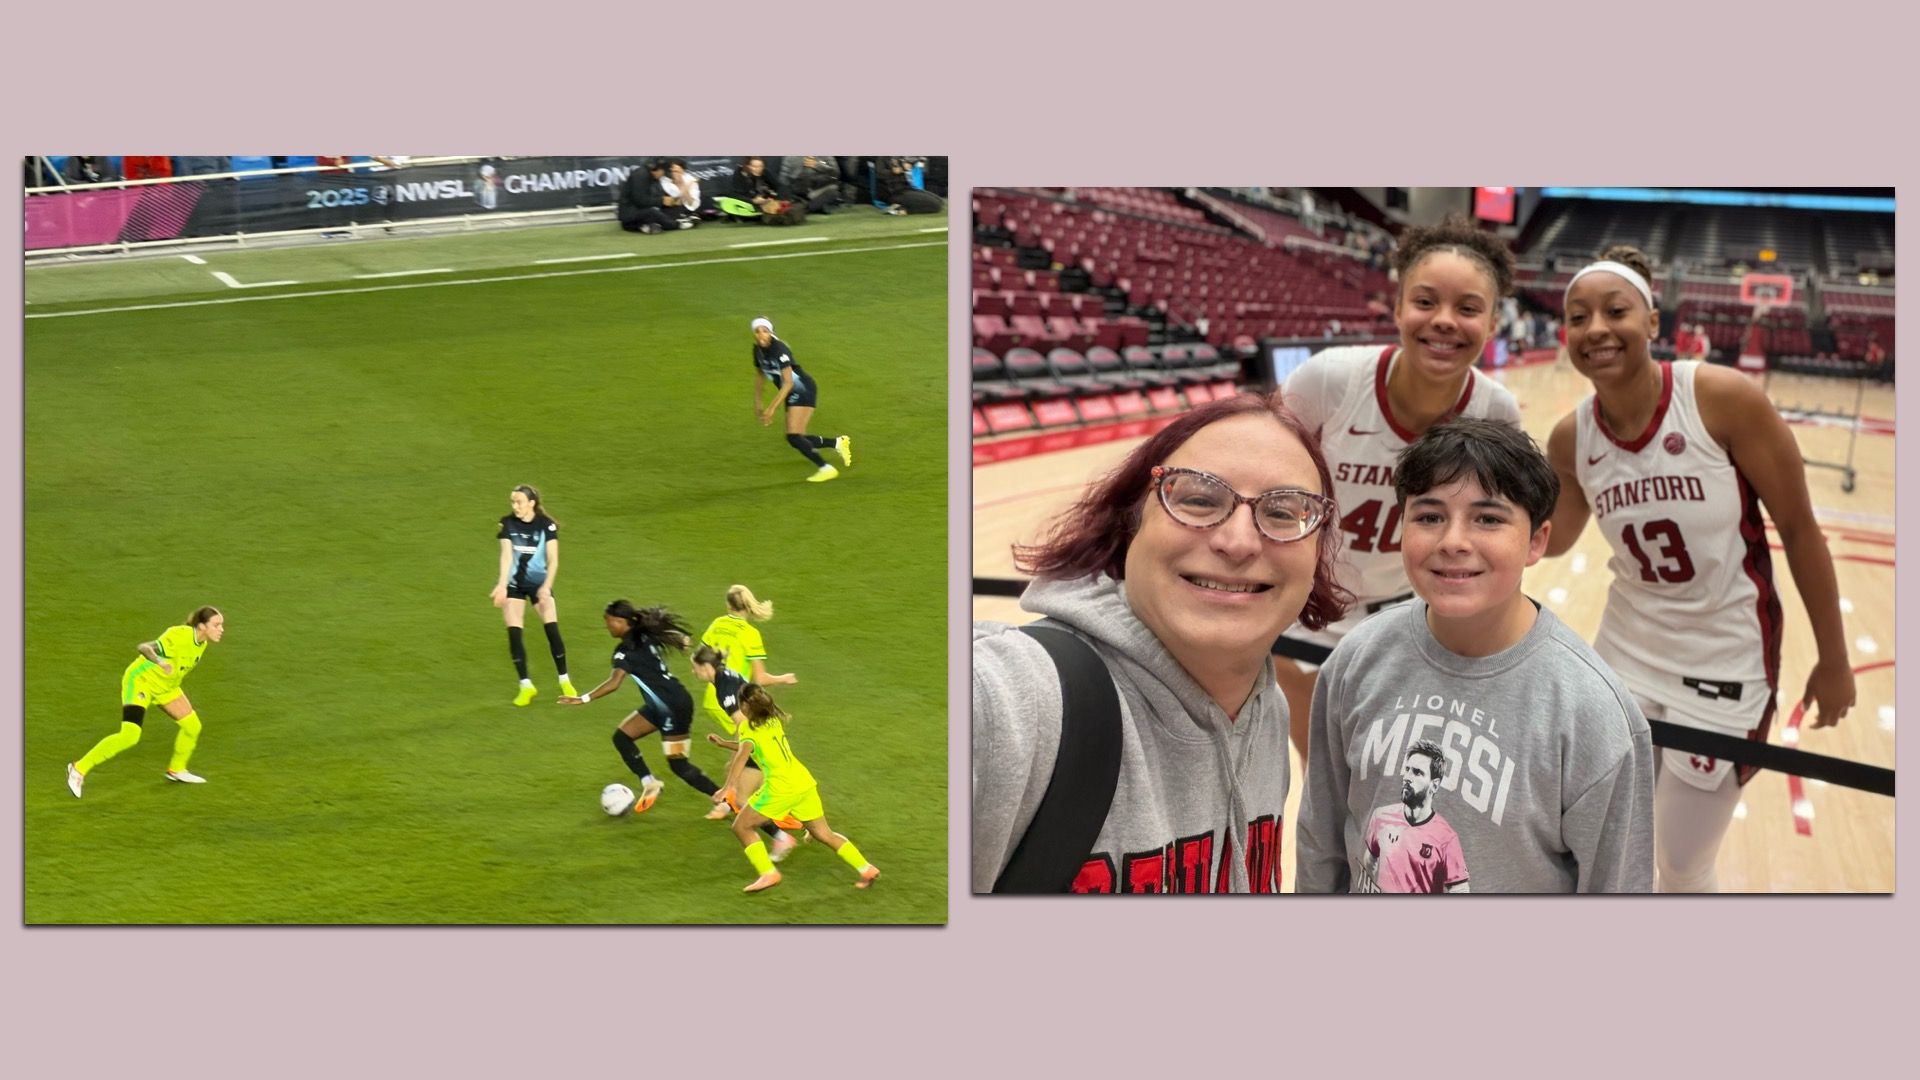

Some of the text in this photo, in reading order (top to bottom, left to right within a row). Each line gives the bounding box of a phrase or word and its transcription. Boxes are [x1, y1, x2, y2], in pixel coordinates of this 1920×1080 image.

[306, 187, 369, 208] 2025
[395, 179, 475, 202] NWSL
[1595, 475, 1705, 519] STANFORD
[1621, 518, 1696, 584] 13
[1394, 694, 1500, 739] LIONEL
[1360, 713, 1516, 827] MESSI
